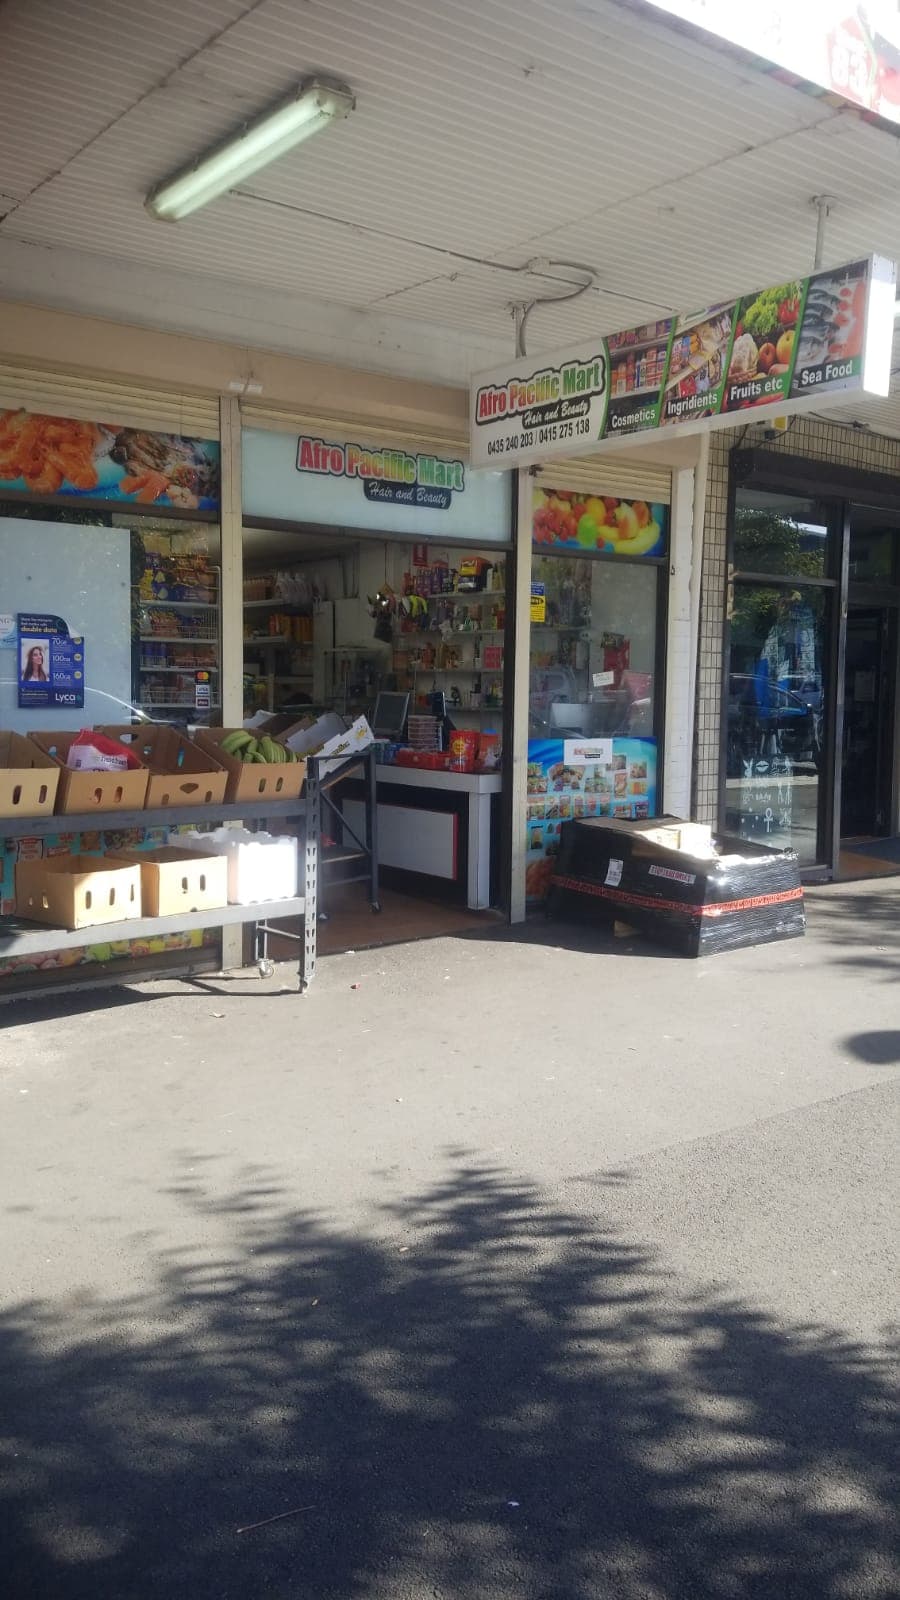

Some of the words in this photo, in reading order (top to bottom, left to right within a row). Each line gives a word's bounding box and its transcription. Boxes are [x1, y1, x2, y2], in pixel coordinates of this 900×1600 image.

[801, 370, 822, 386] Sea
[825, 360, 853, 380] Food
[480, 391, 507, 418] Afro
[509, 374, 561, 410] Pacific
[562, 363, 600, 396] Mart
[730, 382, 762, 401] Fruits
[764, 378, 783, 392] etc
[523, 410, 543, 427] Hair
[543, 406, 560, 421] and
[561, 400, 588, 417] Beauty
[667, 392, 718, 415] Ingridients
[611, 409, 656, 428] Cosmetics
[487, 441, 504, 456] 0435
[505, 435, 519, 452] 240
[520, 431, 534, 449] 203
[539, 426, 557, 444] 0415
[559, 422, 573, 439] 275
[575, 418, 590, 436] 138
[300, 440, 343, 472] Afro
[347, 446, 416, 483] Pacific
[418, 457, 463, 488] Mart
[368, 480, 393, 498] Hair
[395, 487, 414, 501] and
[416, 487, 449, 508] Beauty
[55, 693, 76, 703] Lyca
